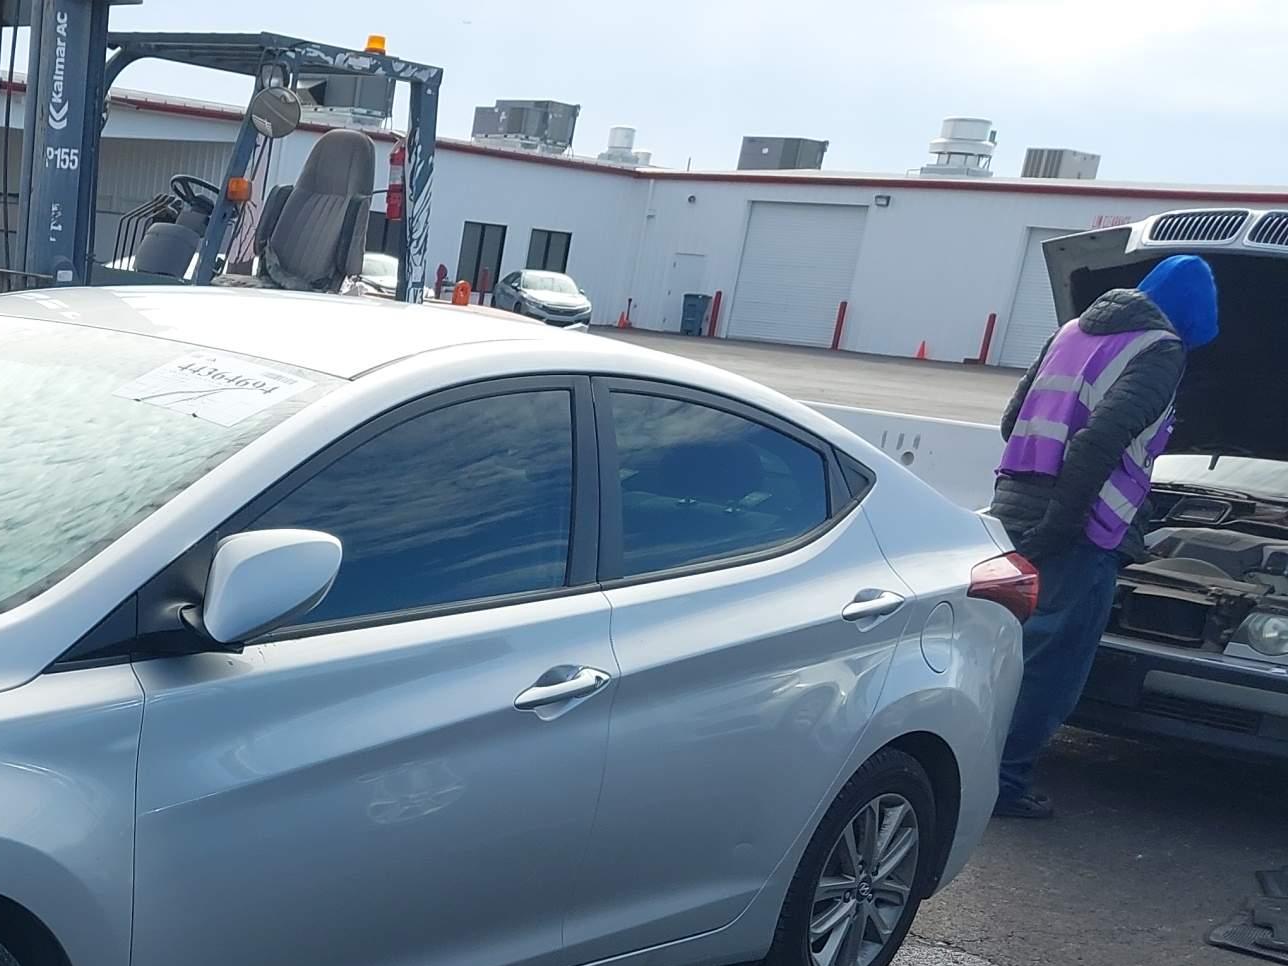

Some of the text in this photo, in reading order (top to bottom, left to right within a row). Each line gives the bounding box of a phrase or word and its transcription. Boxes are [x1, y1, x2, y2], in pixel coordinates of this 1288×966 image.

[51, 11, 68, 103] Kalmar AC
[177, 362, 280, 395] 44364694
